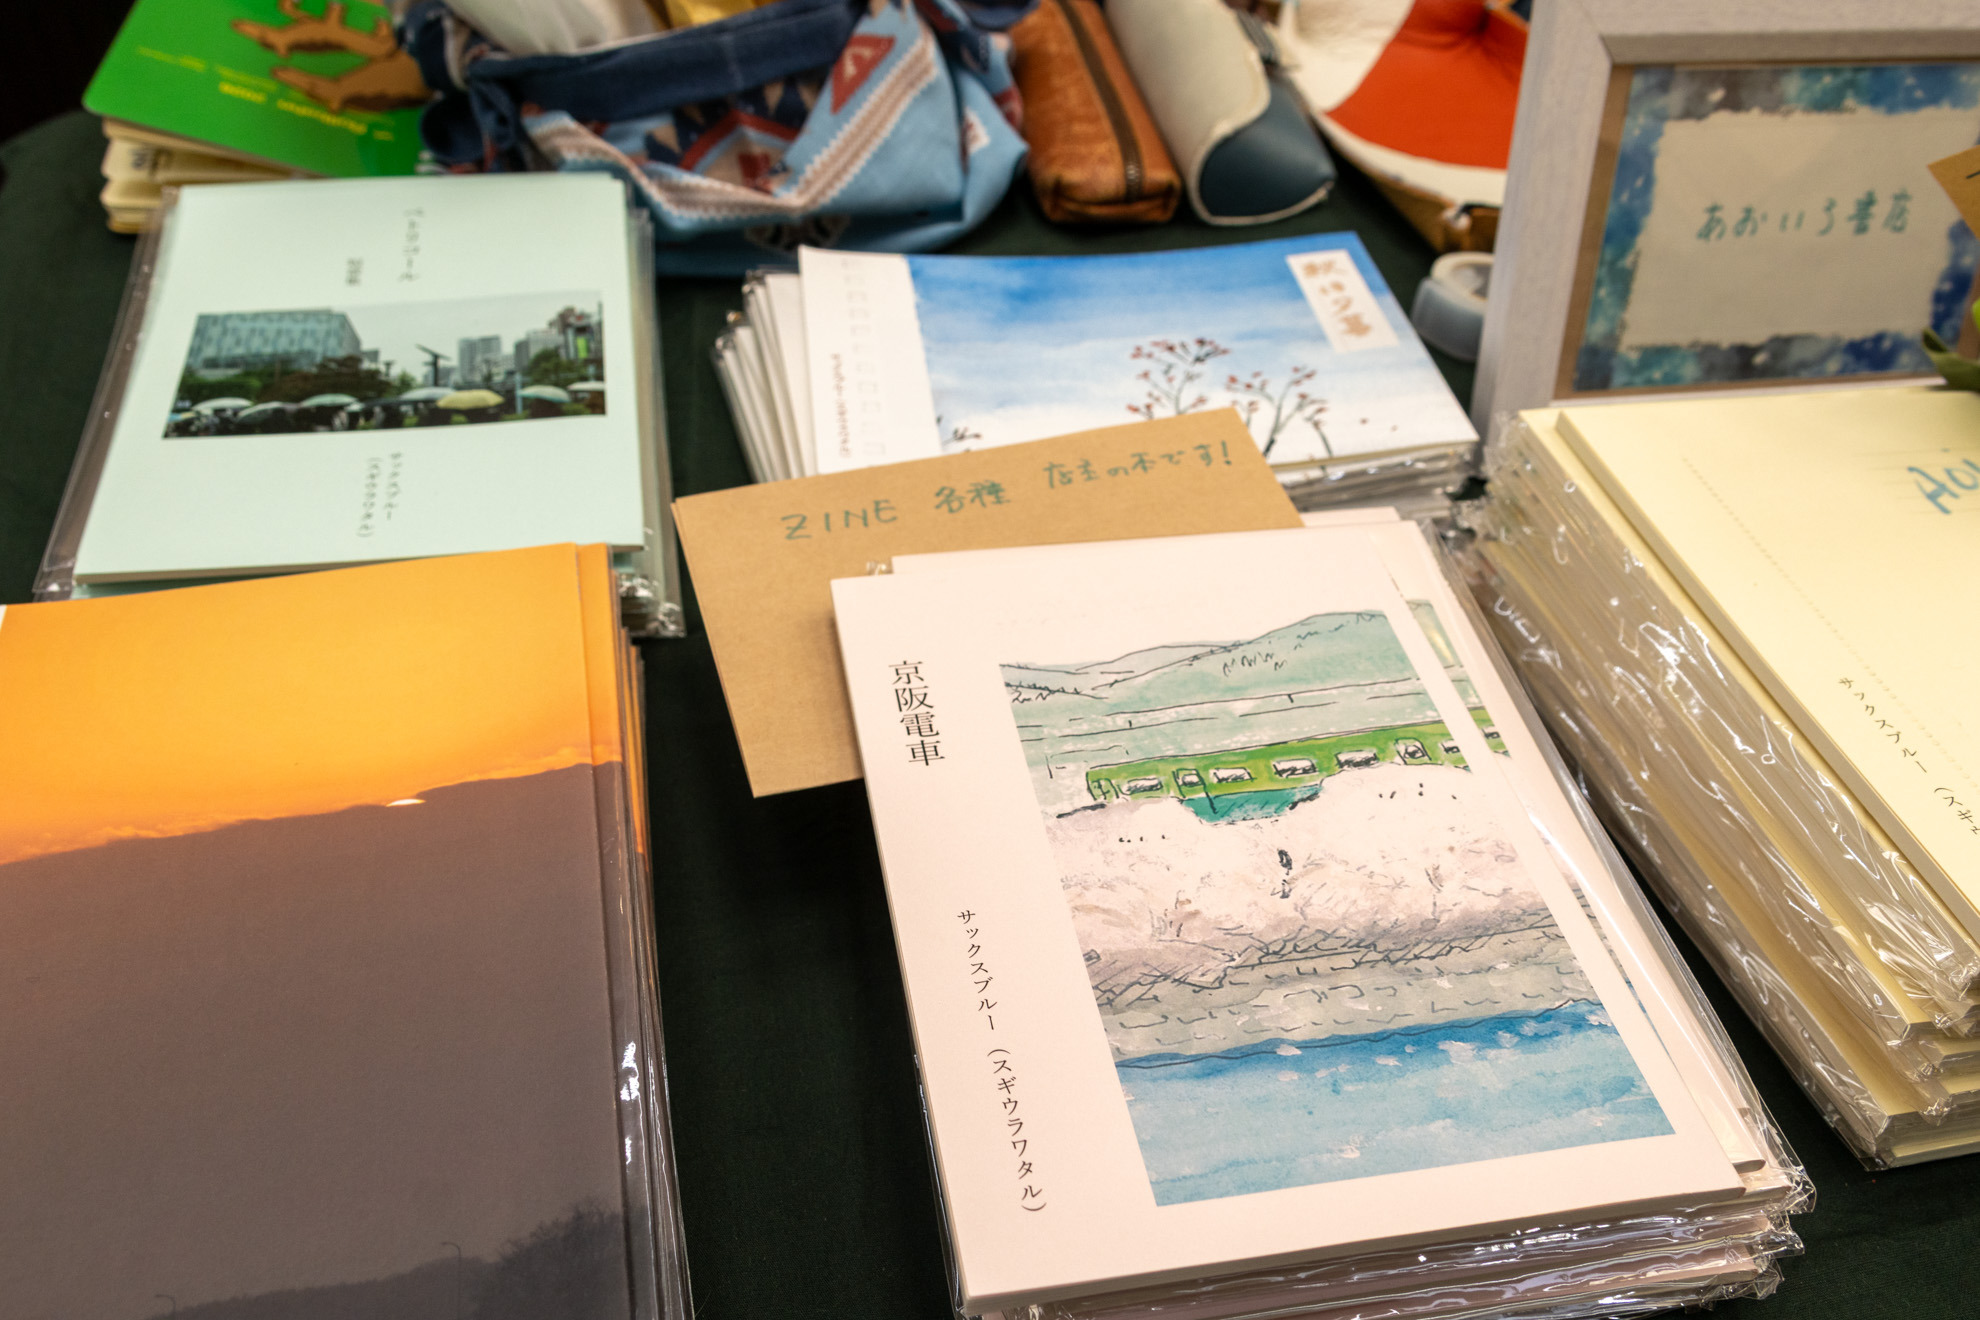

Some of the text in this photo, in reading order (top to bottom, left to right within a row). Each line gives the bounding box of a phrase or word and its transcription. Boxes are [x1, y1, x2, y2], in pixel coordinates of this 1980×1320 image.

[781, 499, 899, 541] ZINE
[935, 481, 1012, 514] 各種
[888, 660, 945, 766] 京阪電車
